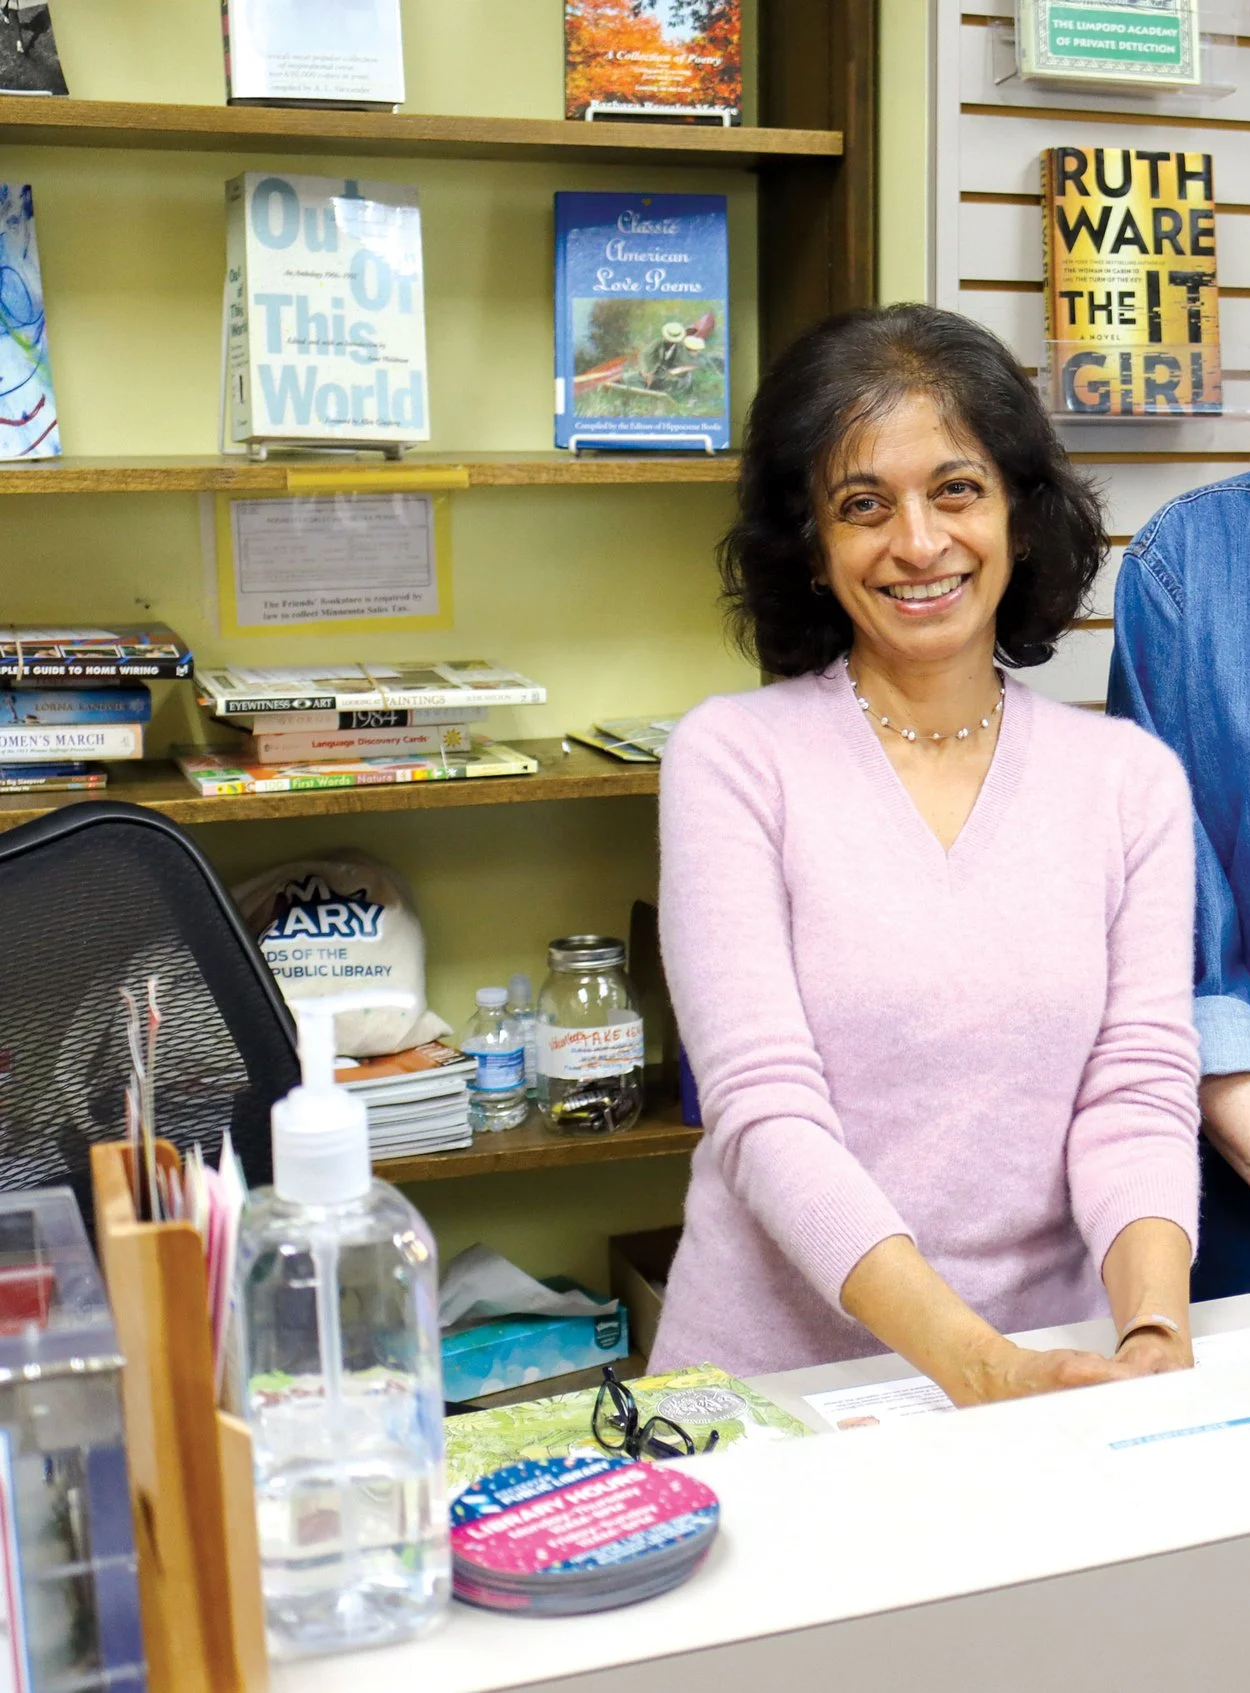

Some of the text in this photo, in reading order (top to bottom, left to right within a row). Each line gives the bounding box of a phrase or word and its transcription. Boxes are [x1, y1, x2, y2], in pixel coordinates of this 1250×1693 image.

[1052, 19, 1178, 37] THE LIMPOPO ACADEMY
[1056, 37, 1176, 54] OF PRIVATE DETECTION
[616, 51, 672, 62] Collection
[674, 53, 687, 64] of
[688, 55, 723, 66] Poetry
[1056, 147, 1213, 201] RUTH
[617, 210, 680, 235] Classic
[1055, 204, 1216, 257] WARE
[605, 238, 690, 264] American
[593, 267, 703, 293] Love Poems
[1059, 270, 1217, 344] THE IT
[253, 292, 379, 365] This
[1063, 351, 1222, 415] GIRL
[257, 363, 424, 429] World
[263, 601, 279, 609] The
[291, 610, 318, 619] collect
[321, 607, 365, 617] Minnesota
[367, 606, 388, 614] Sales
[0, 666, 159, 675] PLETE GUIDE TO HOME WIRING
[34, 703, 73, 711] LORNA
[351, 710, 399, 728] 1984
[312, 736, 427, 748] Language Discovery Cards
[272, 965, 392, 978] PUBLIC LIBRARY
[466, 1496, 564, 1539] LIBRARY
[565, 1468, 648, 1505] HOURS
